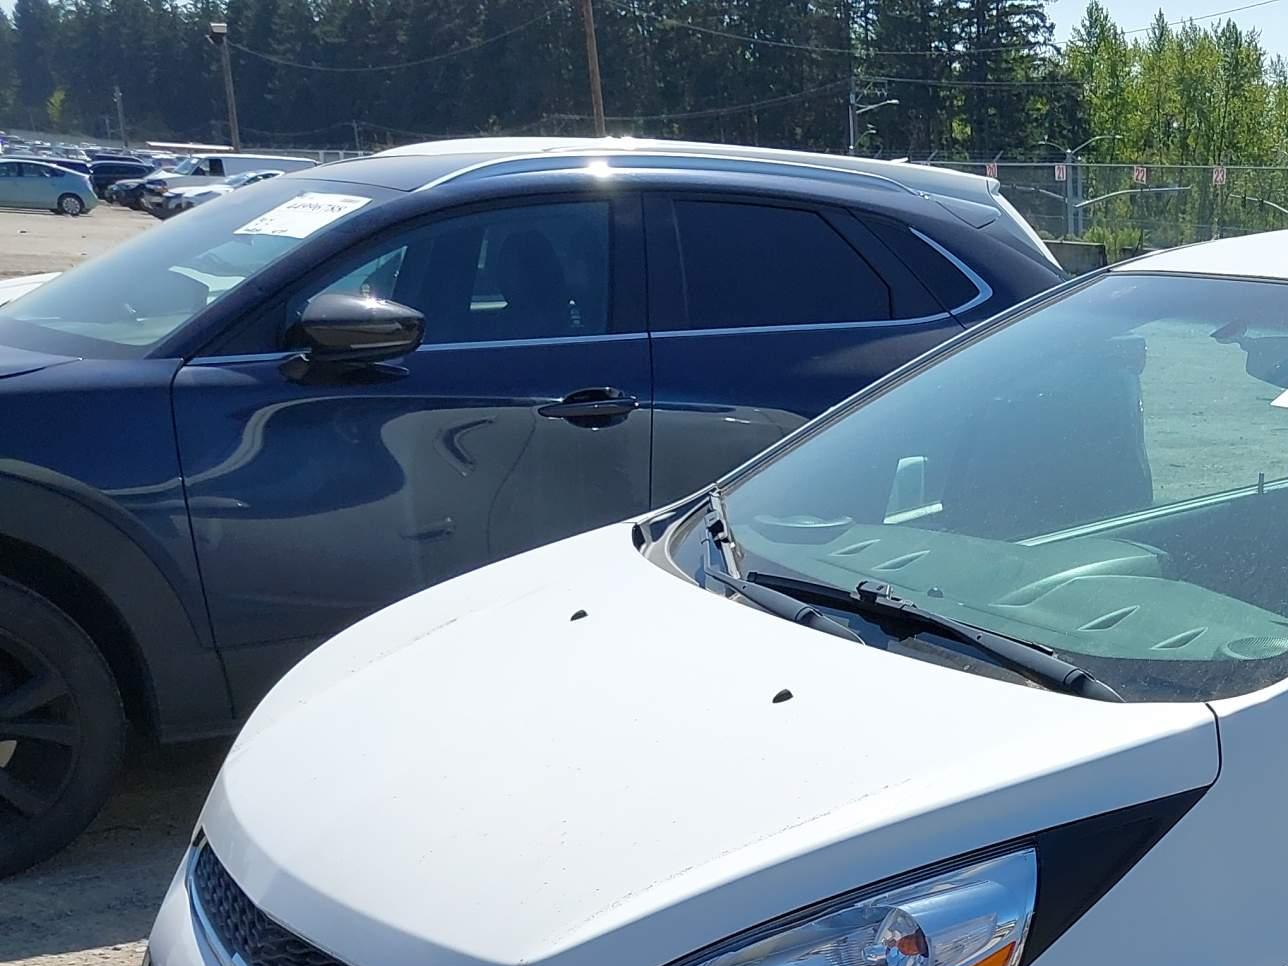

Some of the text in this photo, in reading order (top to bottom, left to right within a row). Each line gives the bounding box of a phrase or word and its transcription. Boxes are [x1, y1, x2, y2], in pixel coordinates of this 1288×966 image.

[1056, 165, 1065, 179] 21
[1135, 167, 1146, 182] 22
[1213, 168, 1225, 182] 23
